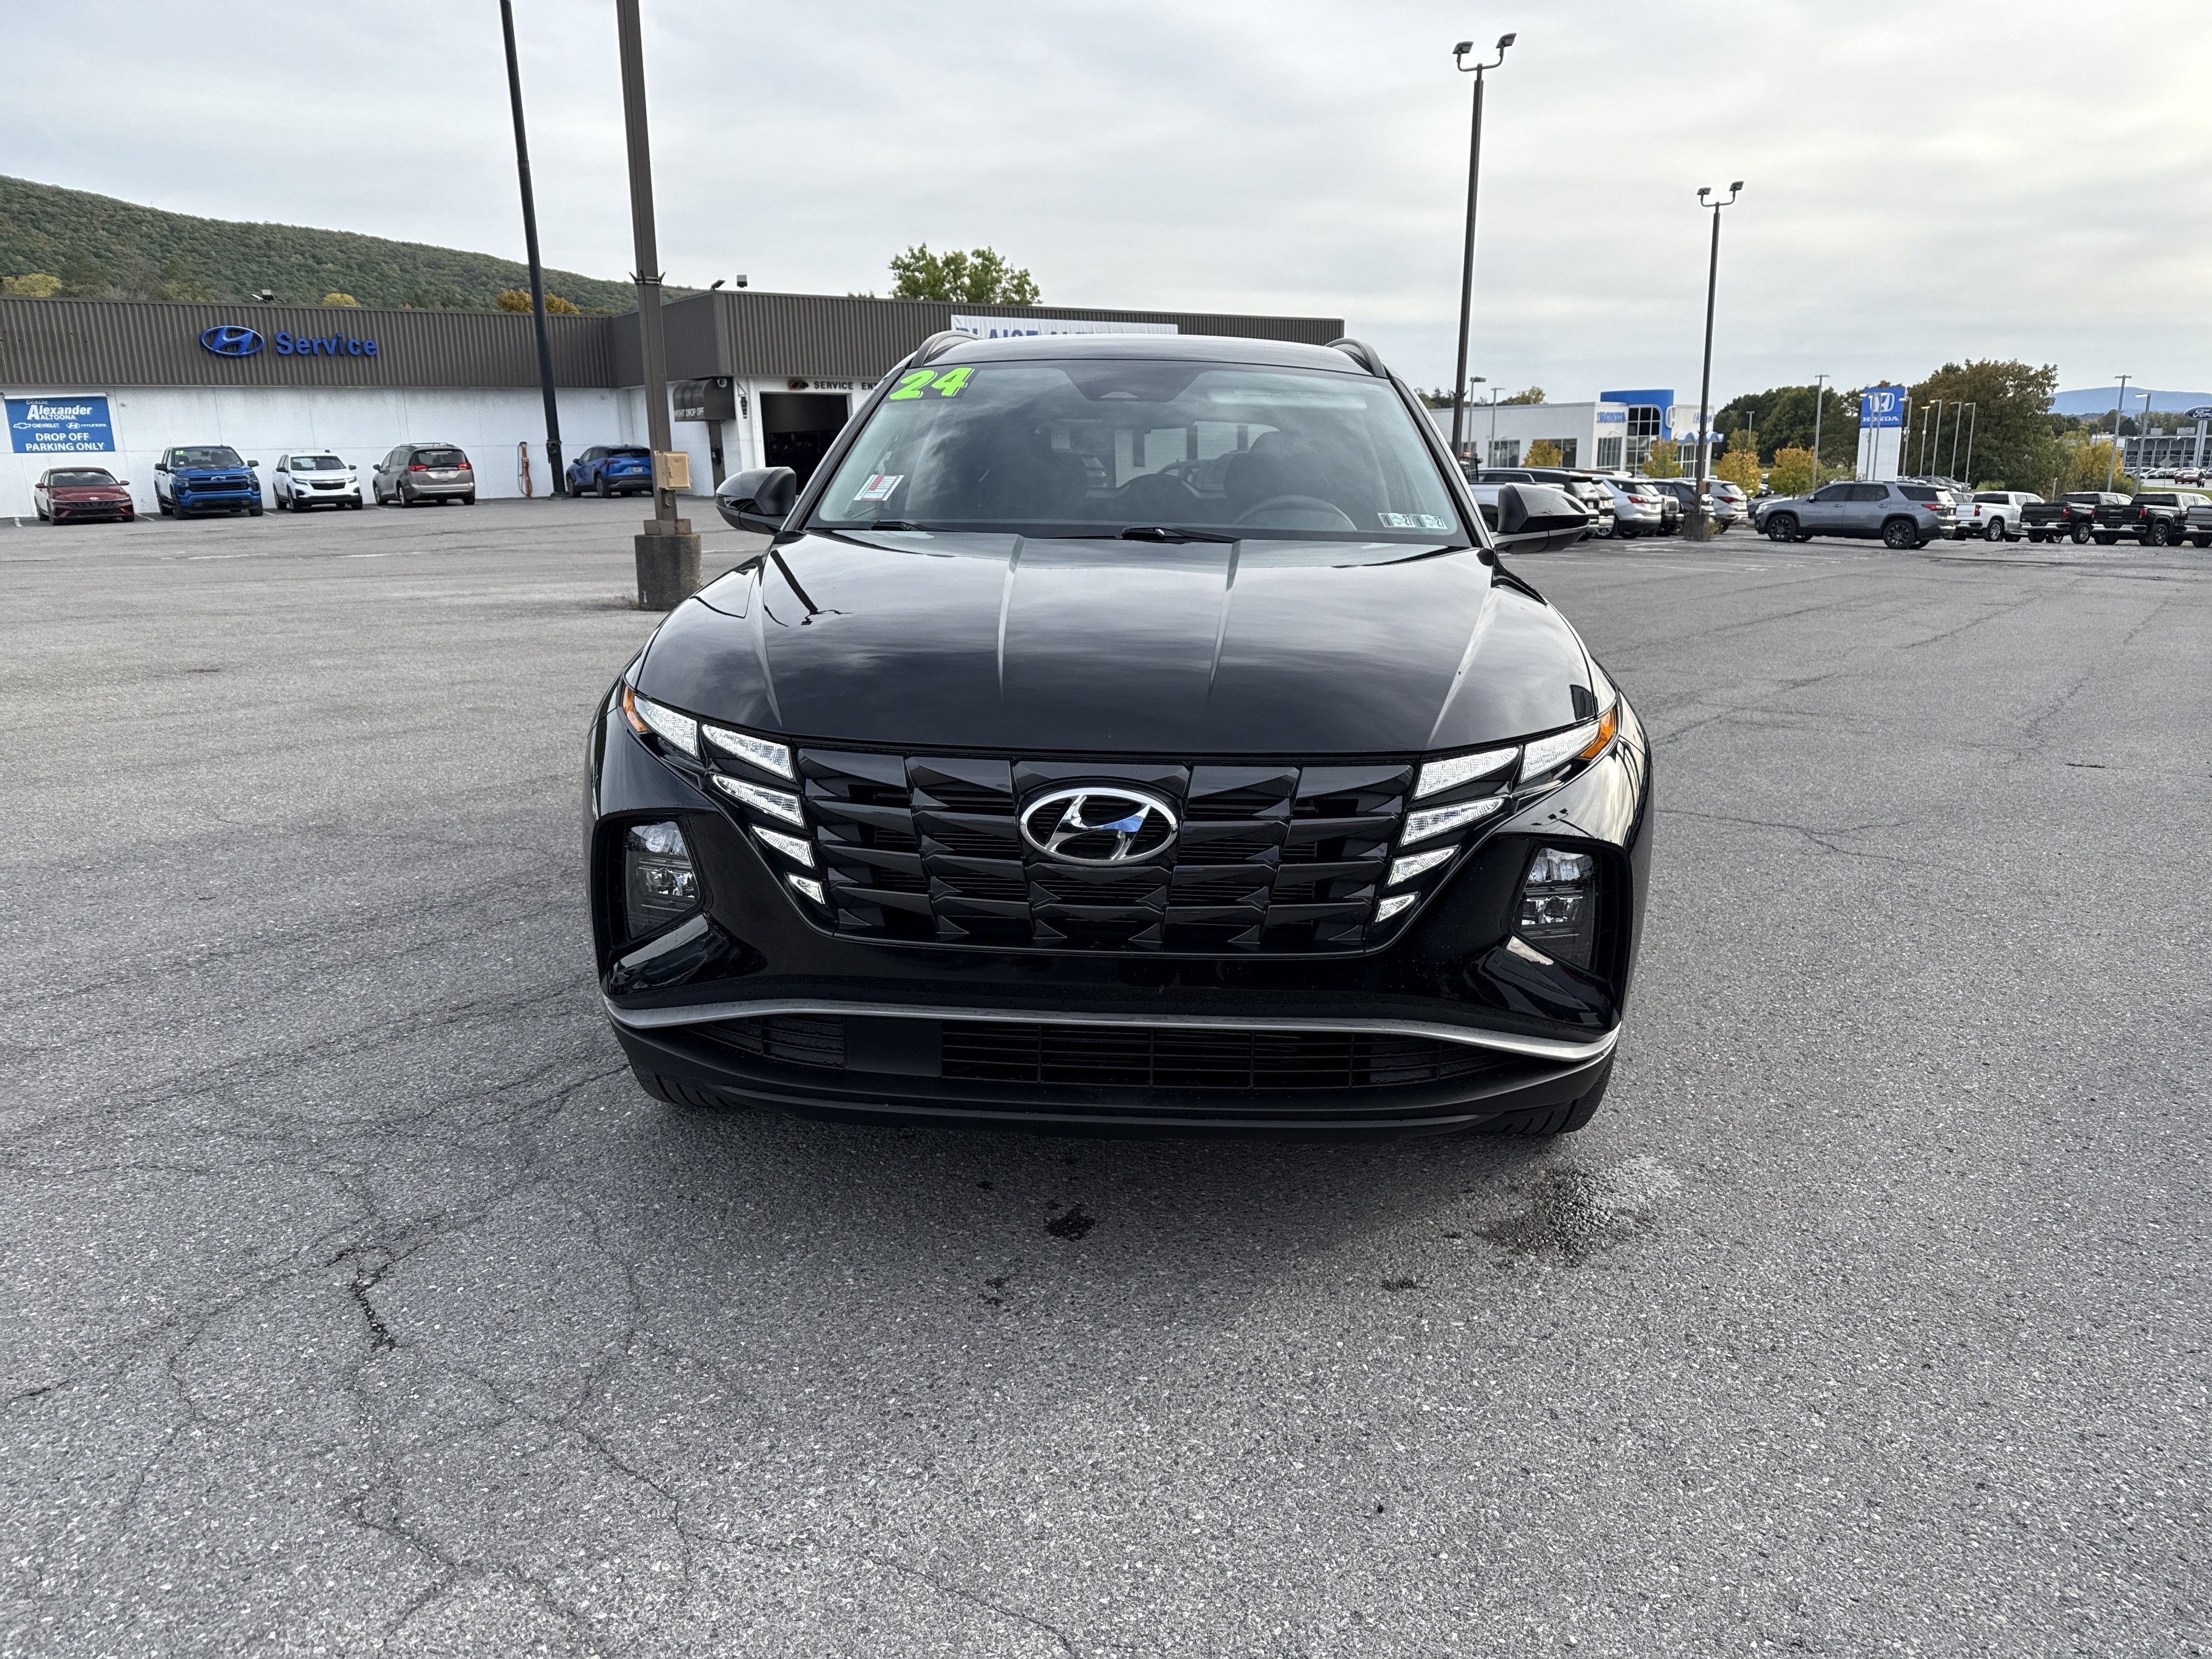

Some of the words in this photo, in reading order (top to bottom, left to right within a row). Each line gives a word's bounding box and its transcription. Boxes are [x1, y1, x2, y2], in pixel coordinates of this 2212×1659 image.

[275, 331, 379, 356] Service
[814, 381, 854, 390] SERVICE
[889, 368, 975, 400] 24
[27, 404, 93, 420] Alexander
[35, 433, 66, 442] DROP
[68, 432, 90, 441] OFF
[25, 443, 74, 451] PARKING
[76, 442, 104, 450] ONLY
